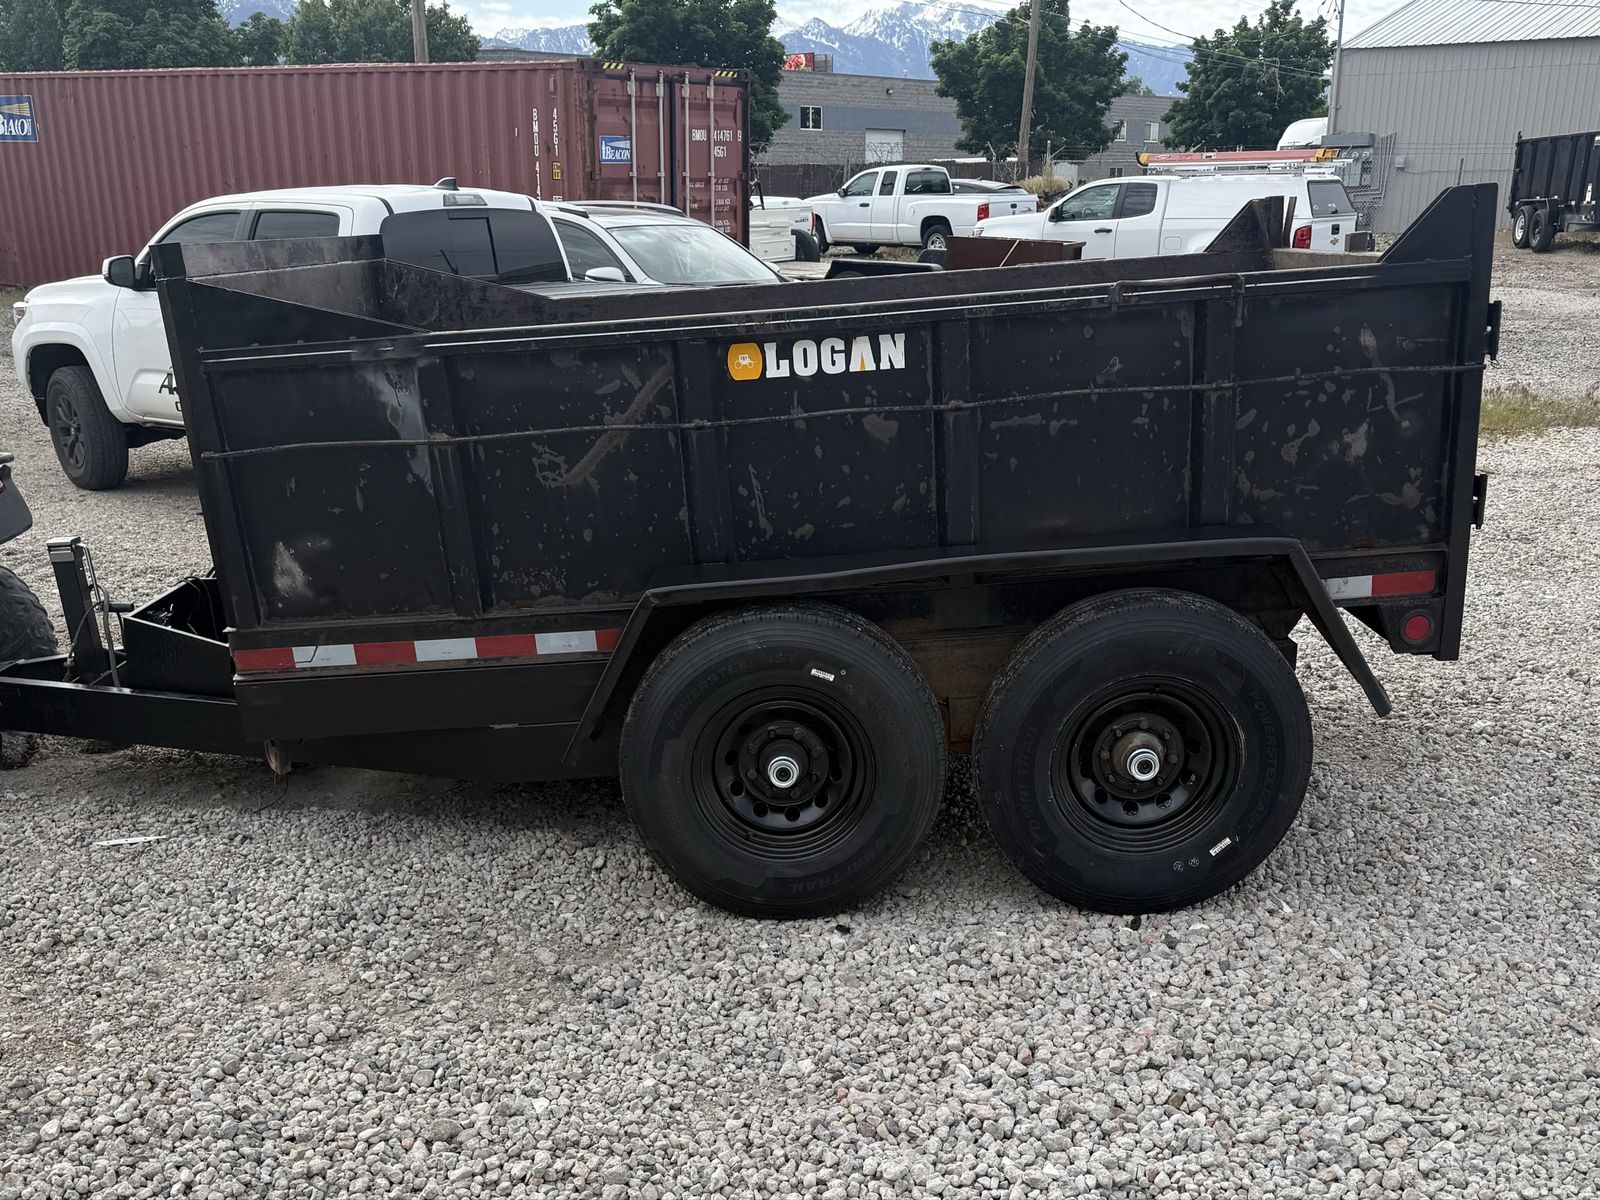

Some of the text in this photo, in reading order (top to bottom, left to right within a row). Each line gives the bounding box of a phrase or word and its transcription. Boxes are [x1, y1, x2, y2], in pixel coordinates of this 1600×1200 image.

[532, 108, 540, 157] BMOU
[691, 129, 742, 142] BMOU 414761 9
[605, 145, 631, 160] BEACON
[764, 333, 906, 379] LOGAN
